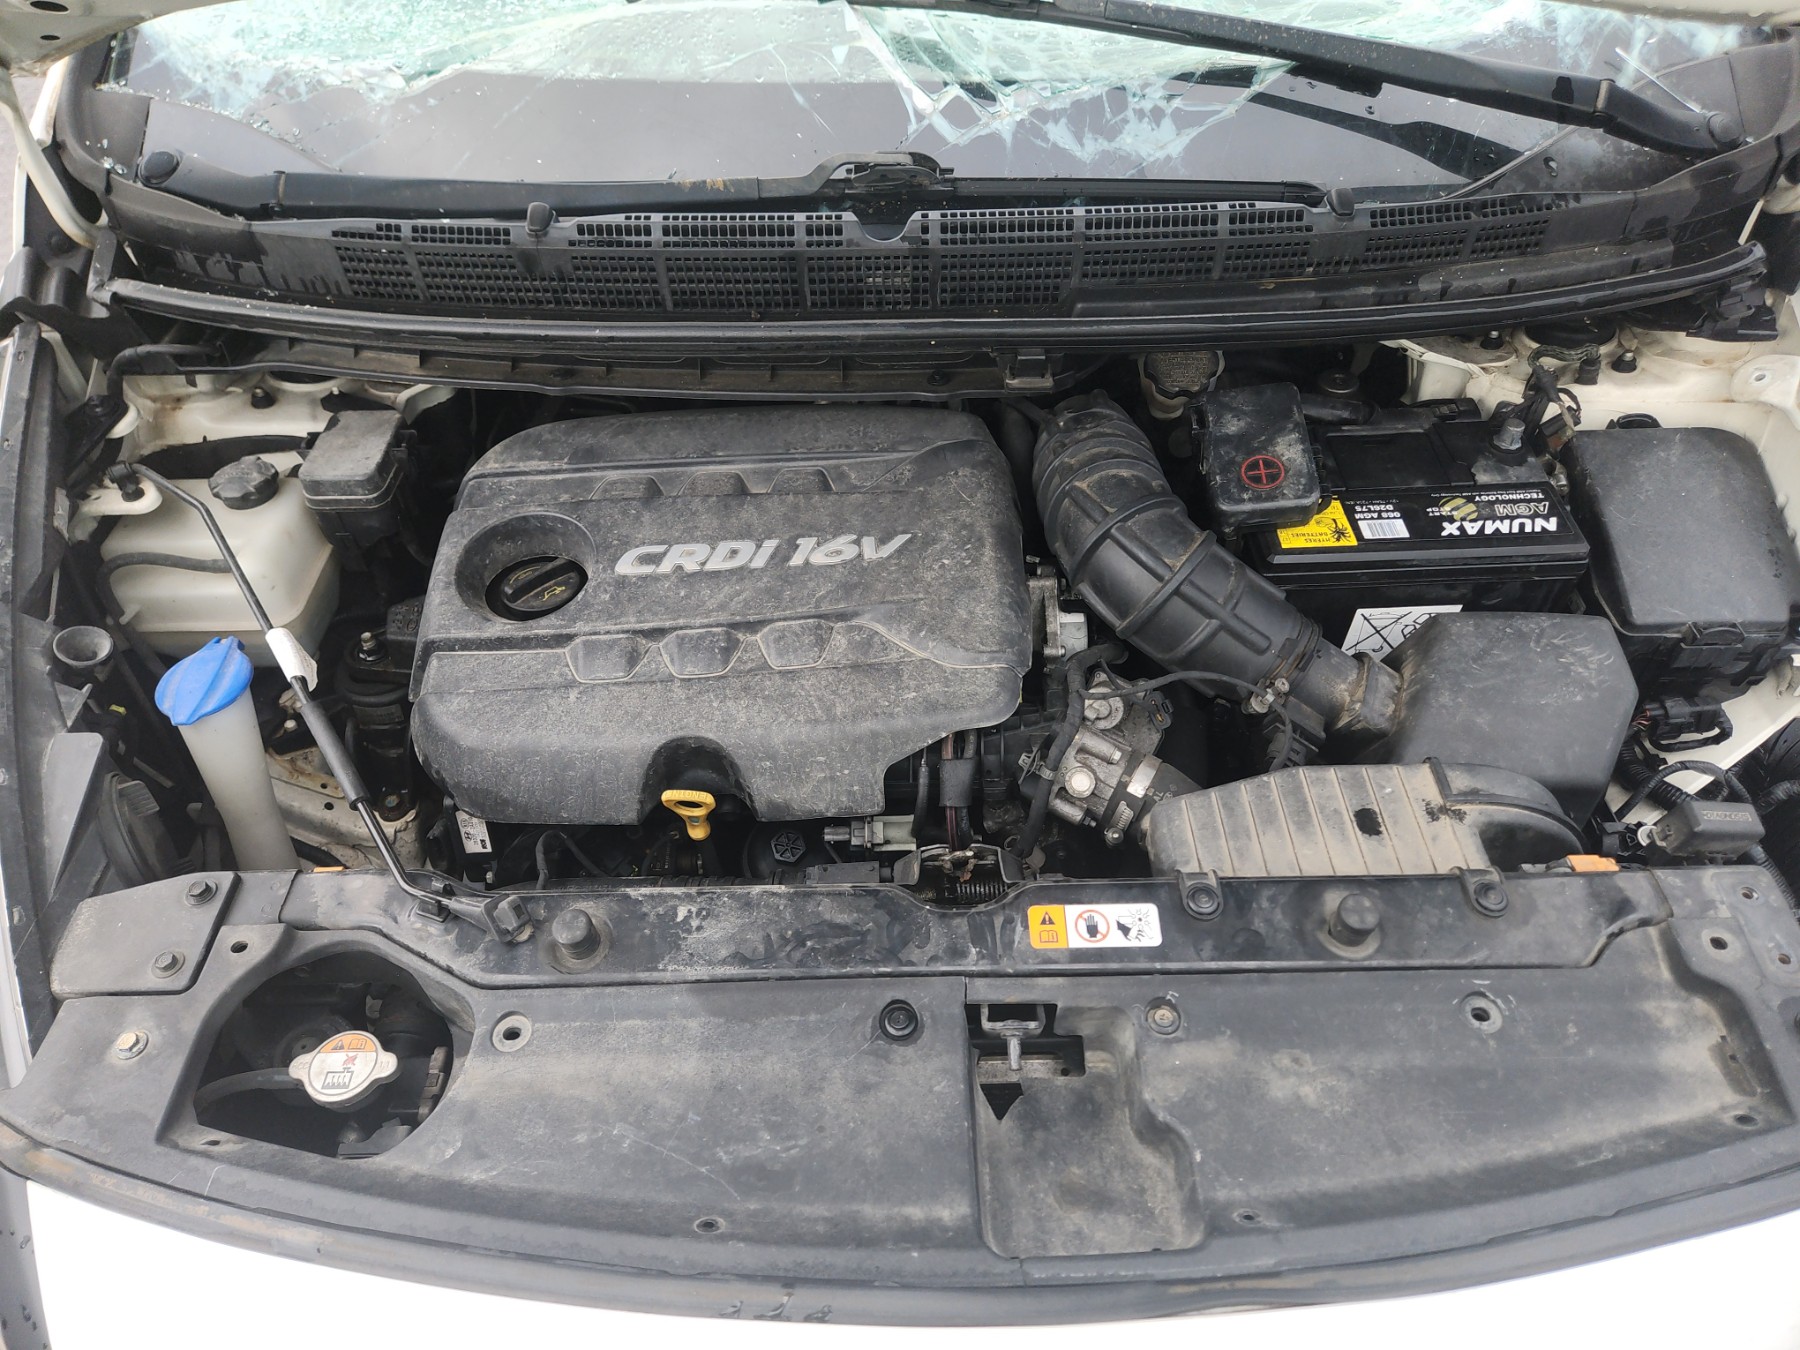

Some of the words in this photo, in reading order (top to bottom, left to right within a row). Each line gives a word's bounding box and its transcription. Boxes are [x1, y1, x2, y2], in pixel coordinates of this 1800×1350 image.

[1474, 493, 1545, 502] TECHNOLOGY
[1494, 502, 1549, 516] AGM
[1440, 517, 1558, 536] NUMAX
[787, 533, 914, 567] 16V
[665, 789, 707, 800] ENGINE
